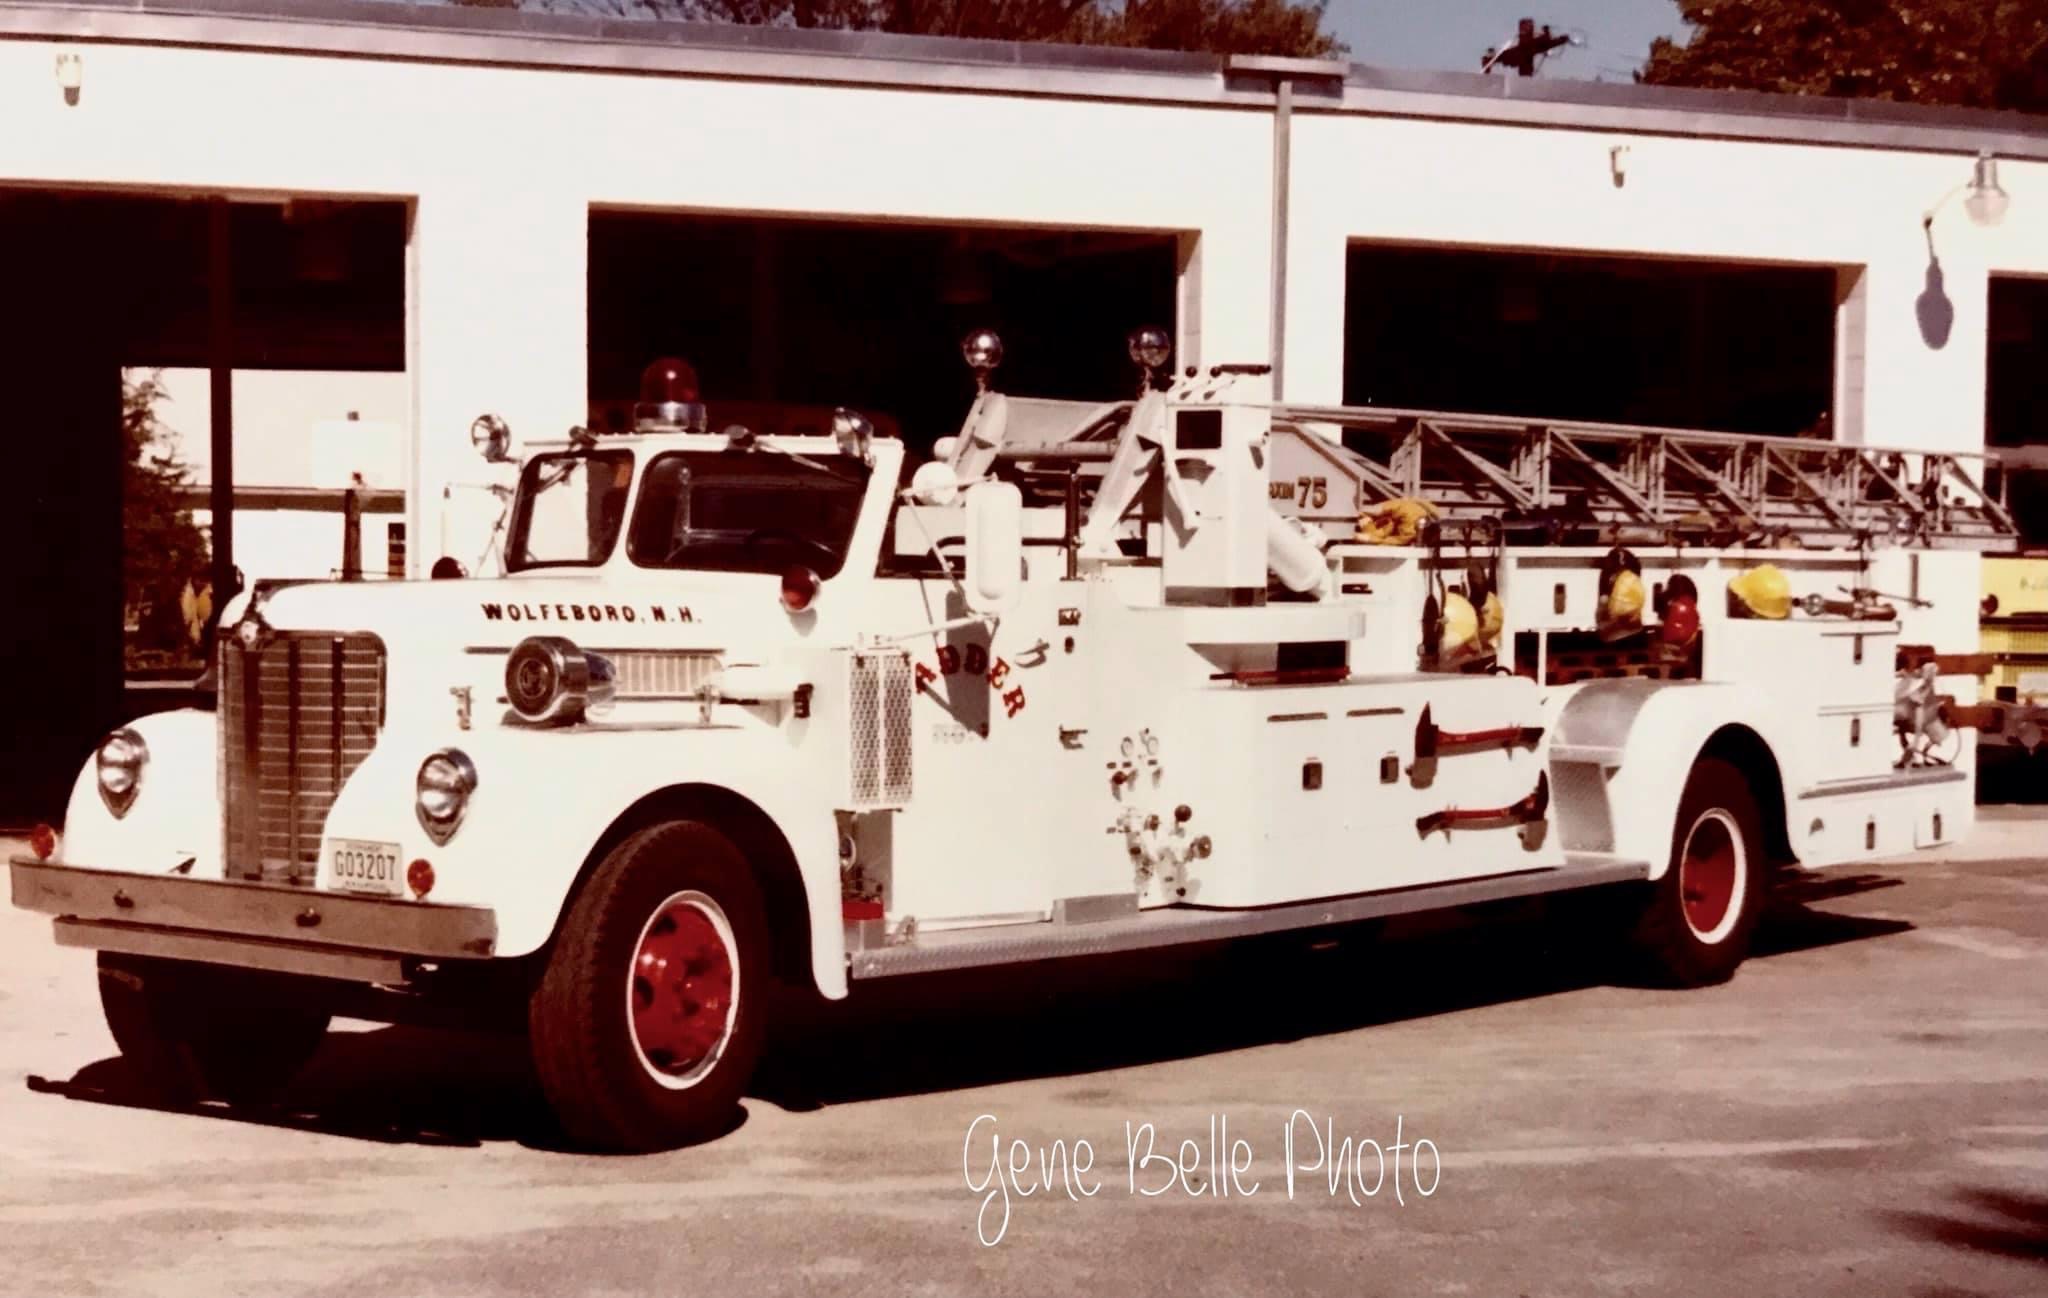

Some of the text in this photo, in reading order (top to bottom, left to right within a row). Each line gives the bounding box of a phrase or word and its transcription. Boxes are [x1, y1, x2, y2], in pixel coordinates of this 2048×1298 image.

[1298, 477, 1327, 509] 75
[650, 605, 703, 623] N.H.
[915, 643, 1026, 718] ADDER
